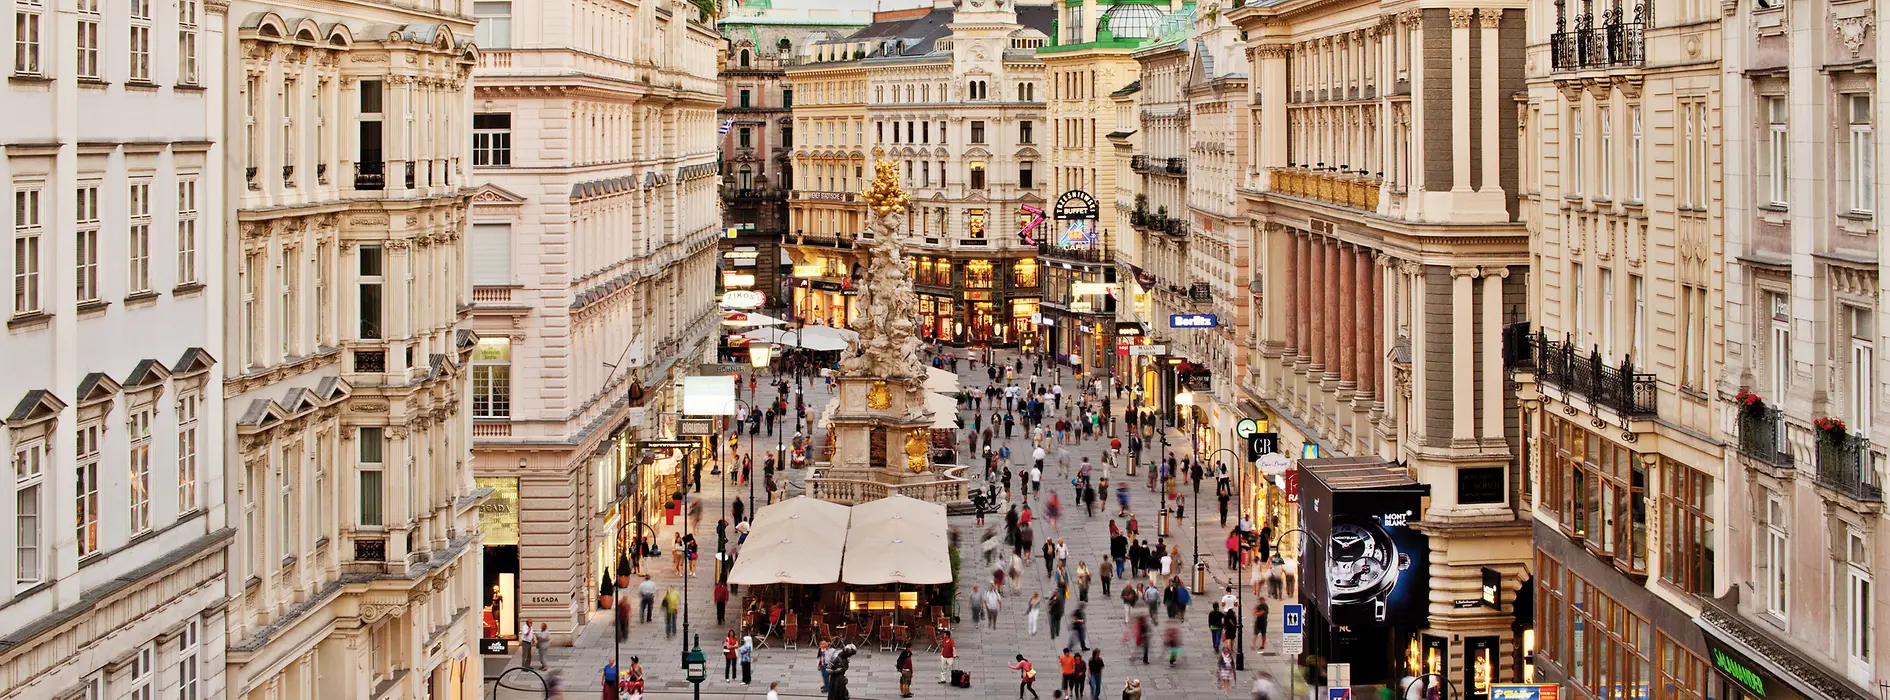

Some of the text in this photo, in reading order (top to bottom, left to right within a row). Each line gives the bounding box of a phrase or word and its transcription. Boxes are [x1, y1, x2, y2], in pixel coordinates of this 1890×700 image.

[1063, 207, 1087, 215] BUFFET
[727, 291, 755, 300] ZIKOS
[1174, 315, 1212, 326] Berlitz
[1253, 438, 1271, 454] GR
[479, 503, 510, 513] SCADA
[1713, 647, 1767, 697] SALAMANDER
